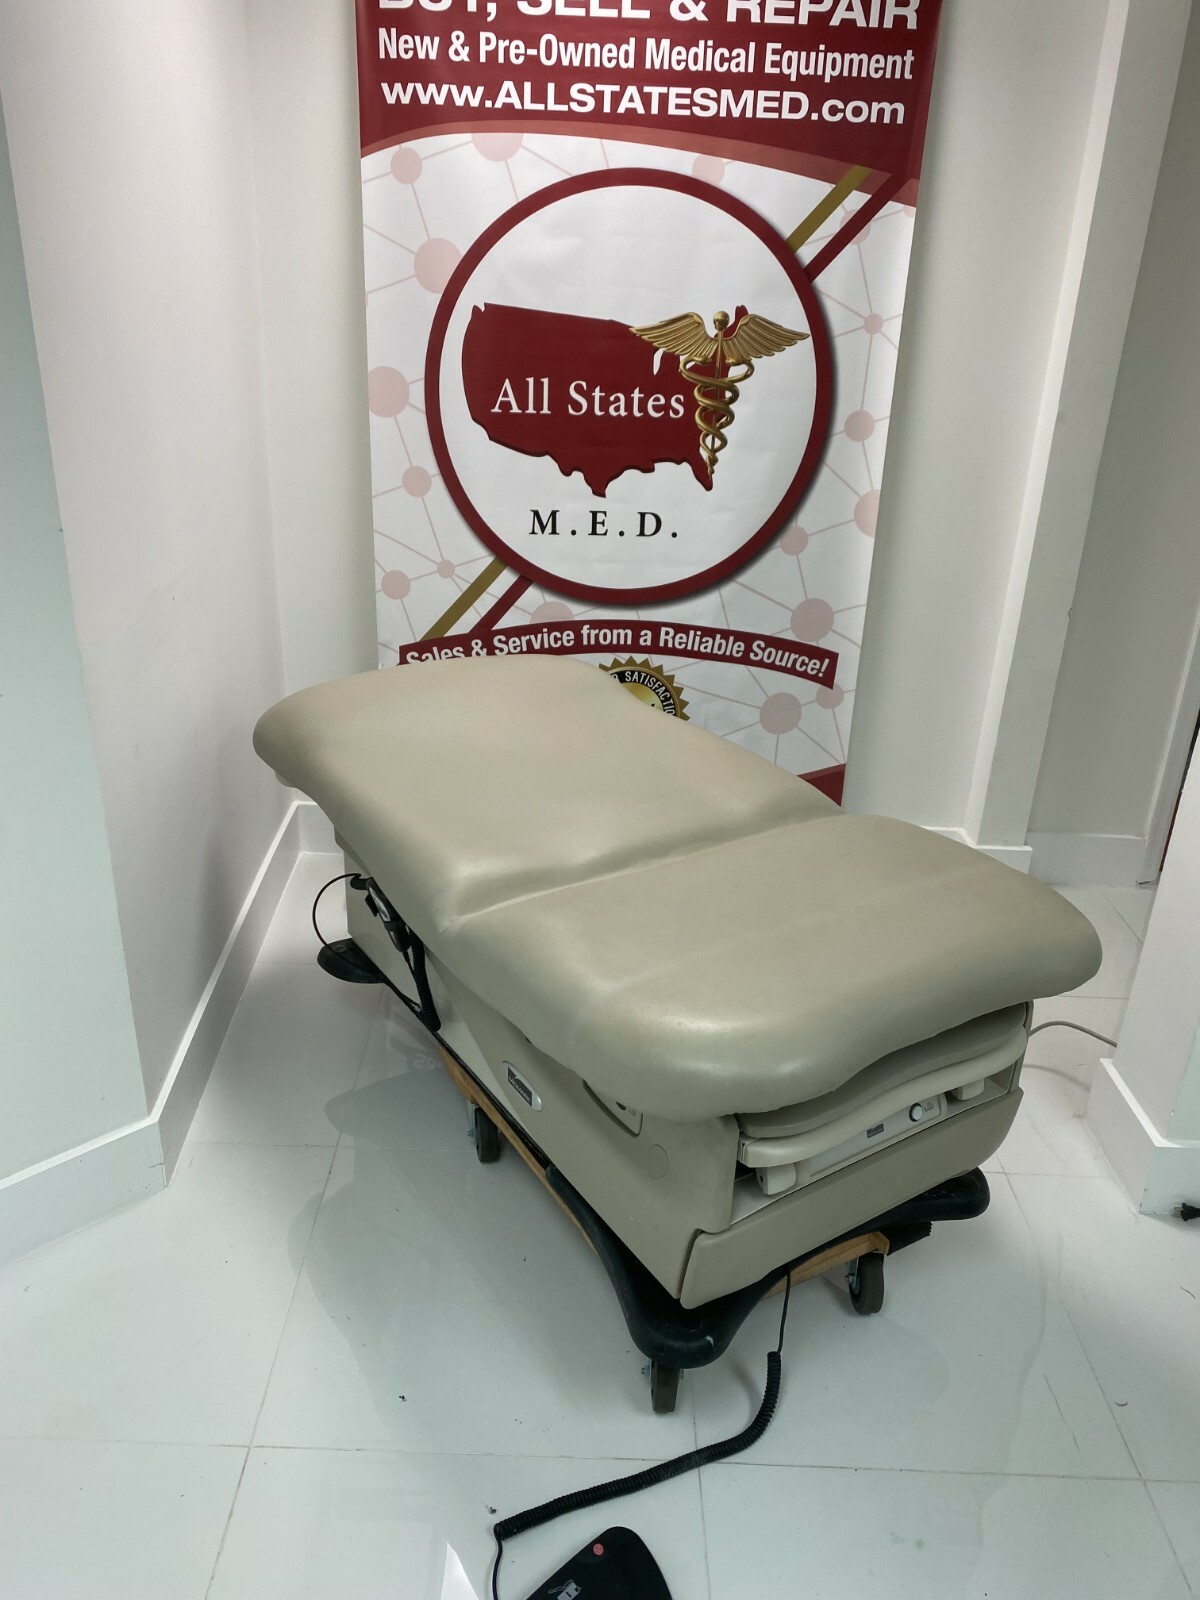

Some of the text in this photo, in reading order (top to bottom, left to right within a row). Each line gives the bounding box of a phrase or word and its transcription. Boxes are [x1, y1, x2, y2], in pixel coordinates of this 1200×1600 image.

[669, 0, 709, 22] &
[726, 0, 918, 30] REPAIR
[378, 27, 915, 83] New & Pre-Owned Medical Equipment
[380, 80, 905, 125] www.ALLSTATESMED.com
[490, 376, 685, 419] All States
[528, 509, 678, 538] M.E.D.
[471, 639, 487, 657] &
[493, 627, 575, 656] Service
[580, 624, 632, 646] from
[639, 629, 652, 646] a
[659, 626, 745, 658] Reliable
[749, 639, 830, 678] Source!
[624, 670, 676, 716] SATISFACTIO
